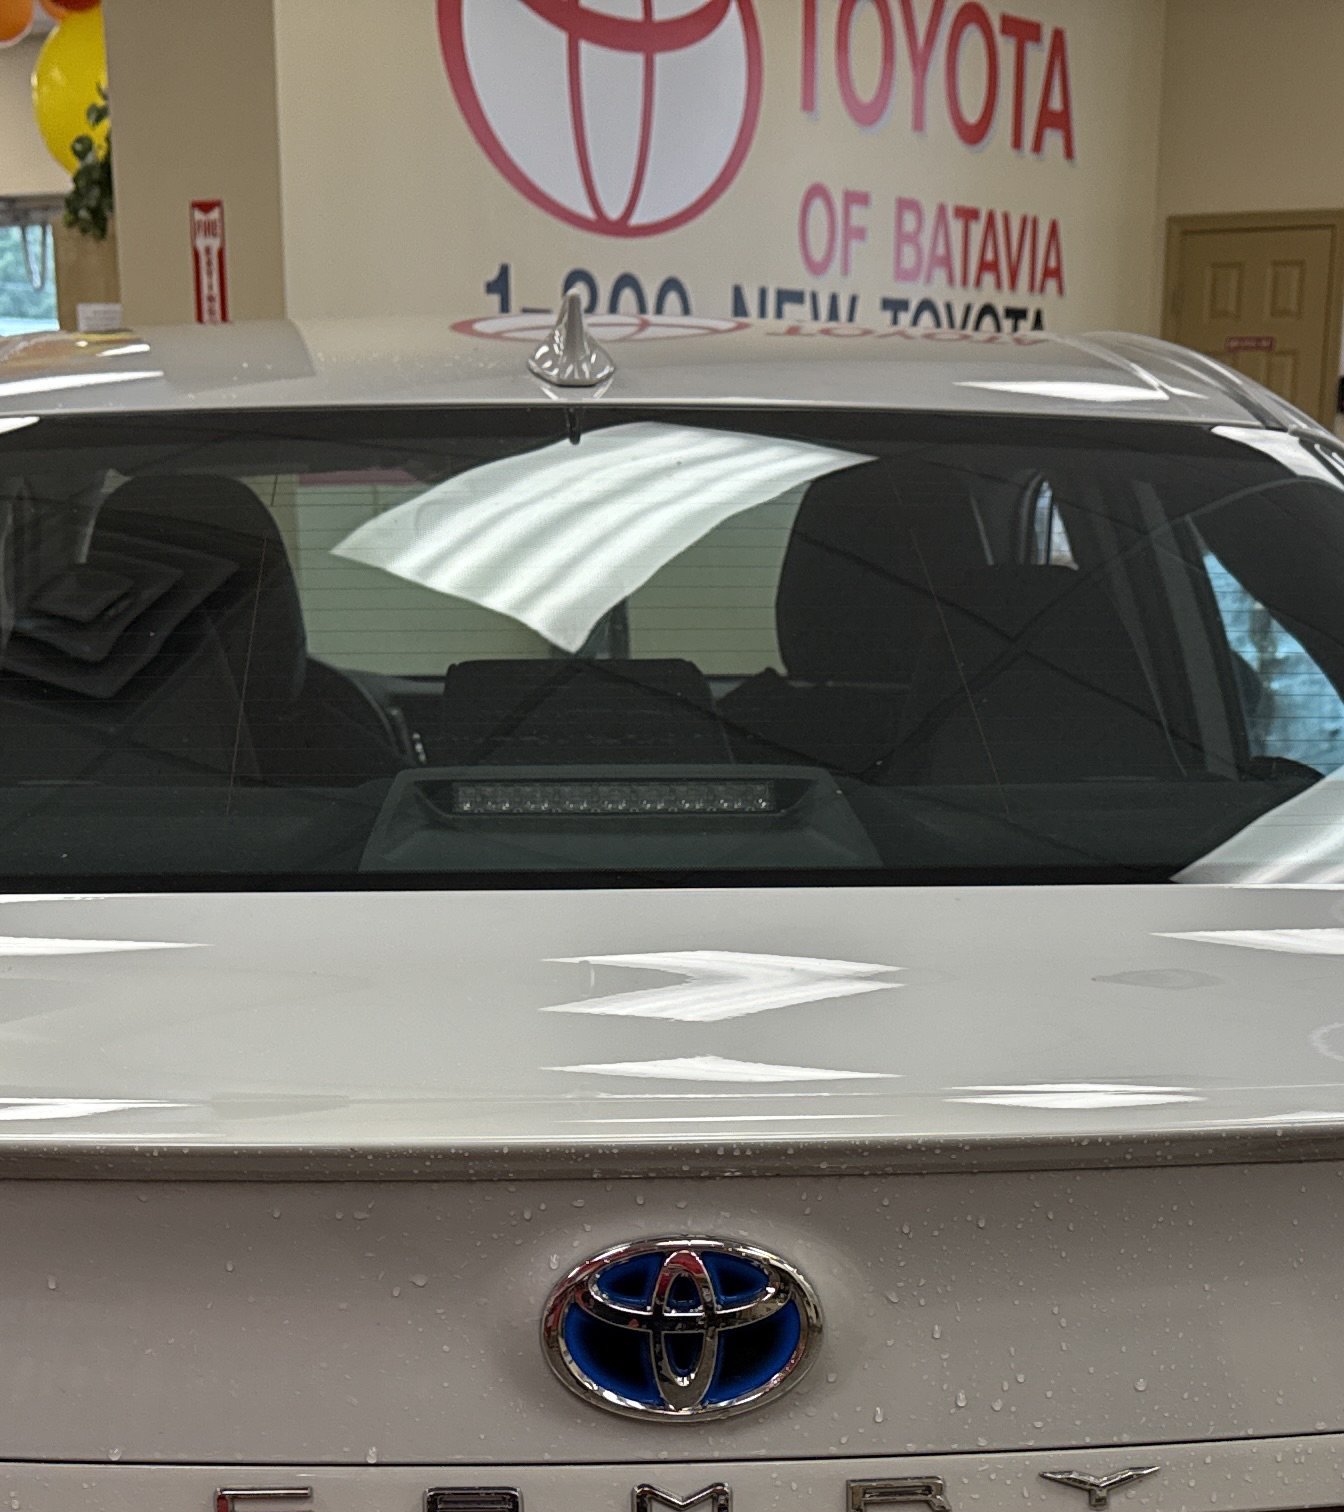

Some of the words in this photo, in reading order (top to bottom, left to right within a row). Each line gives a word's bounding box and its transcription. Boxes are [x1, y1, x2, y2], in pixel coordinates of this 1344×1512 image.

[800, 0, 1075, 161] TOYOTA
[798, 182, 870, 277] OF
[893, 196, 1064, 297] BATAVIA
